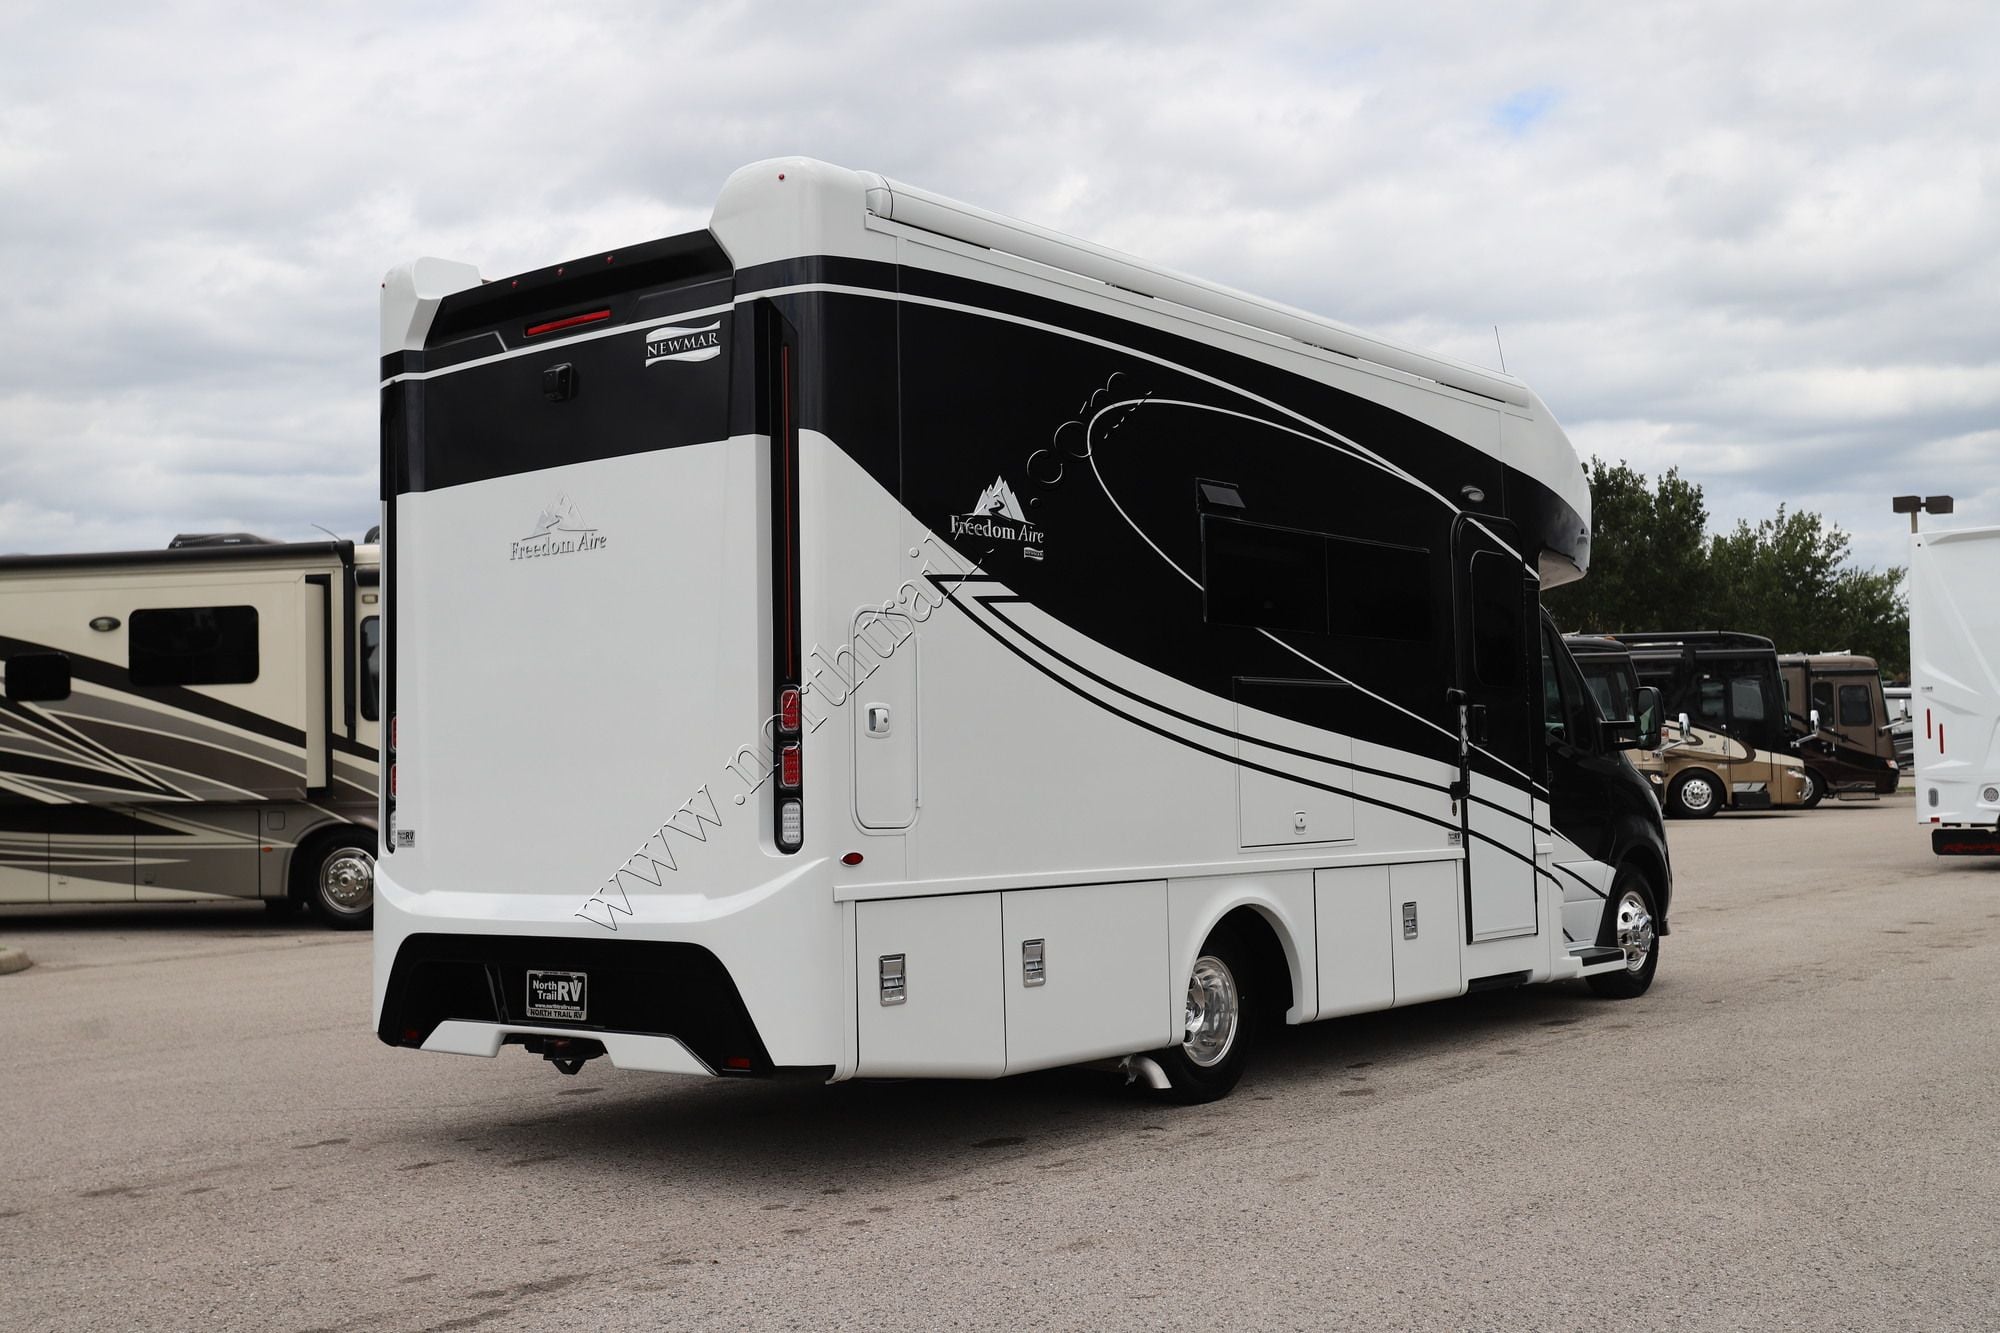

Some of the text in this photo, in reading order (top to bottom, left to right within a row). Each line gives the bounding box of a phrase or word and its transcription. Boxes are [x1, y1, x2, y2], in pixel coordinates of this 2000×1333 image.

[647, 332, 719, 357] NEWMAR
[949, 514, 1044, 543] Freedom Aire
[509, 532, 607, 561] Freedom Aire
[532, 980, 582, 1002] North RV
[537, 990, 557, 1000] Trail
